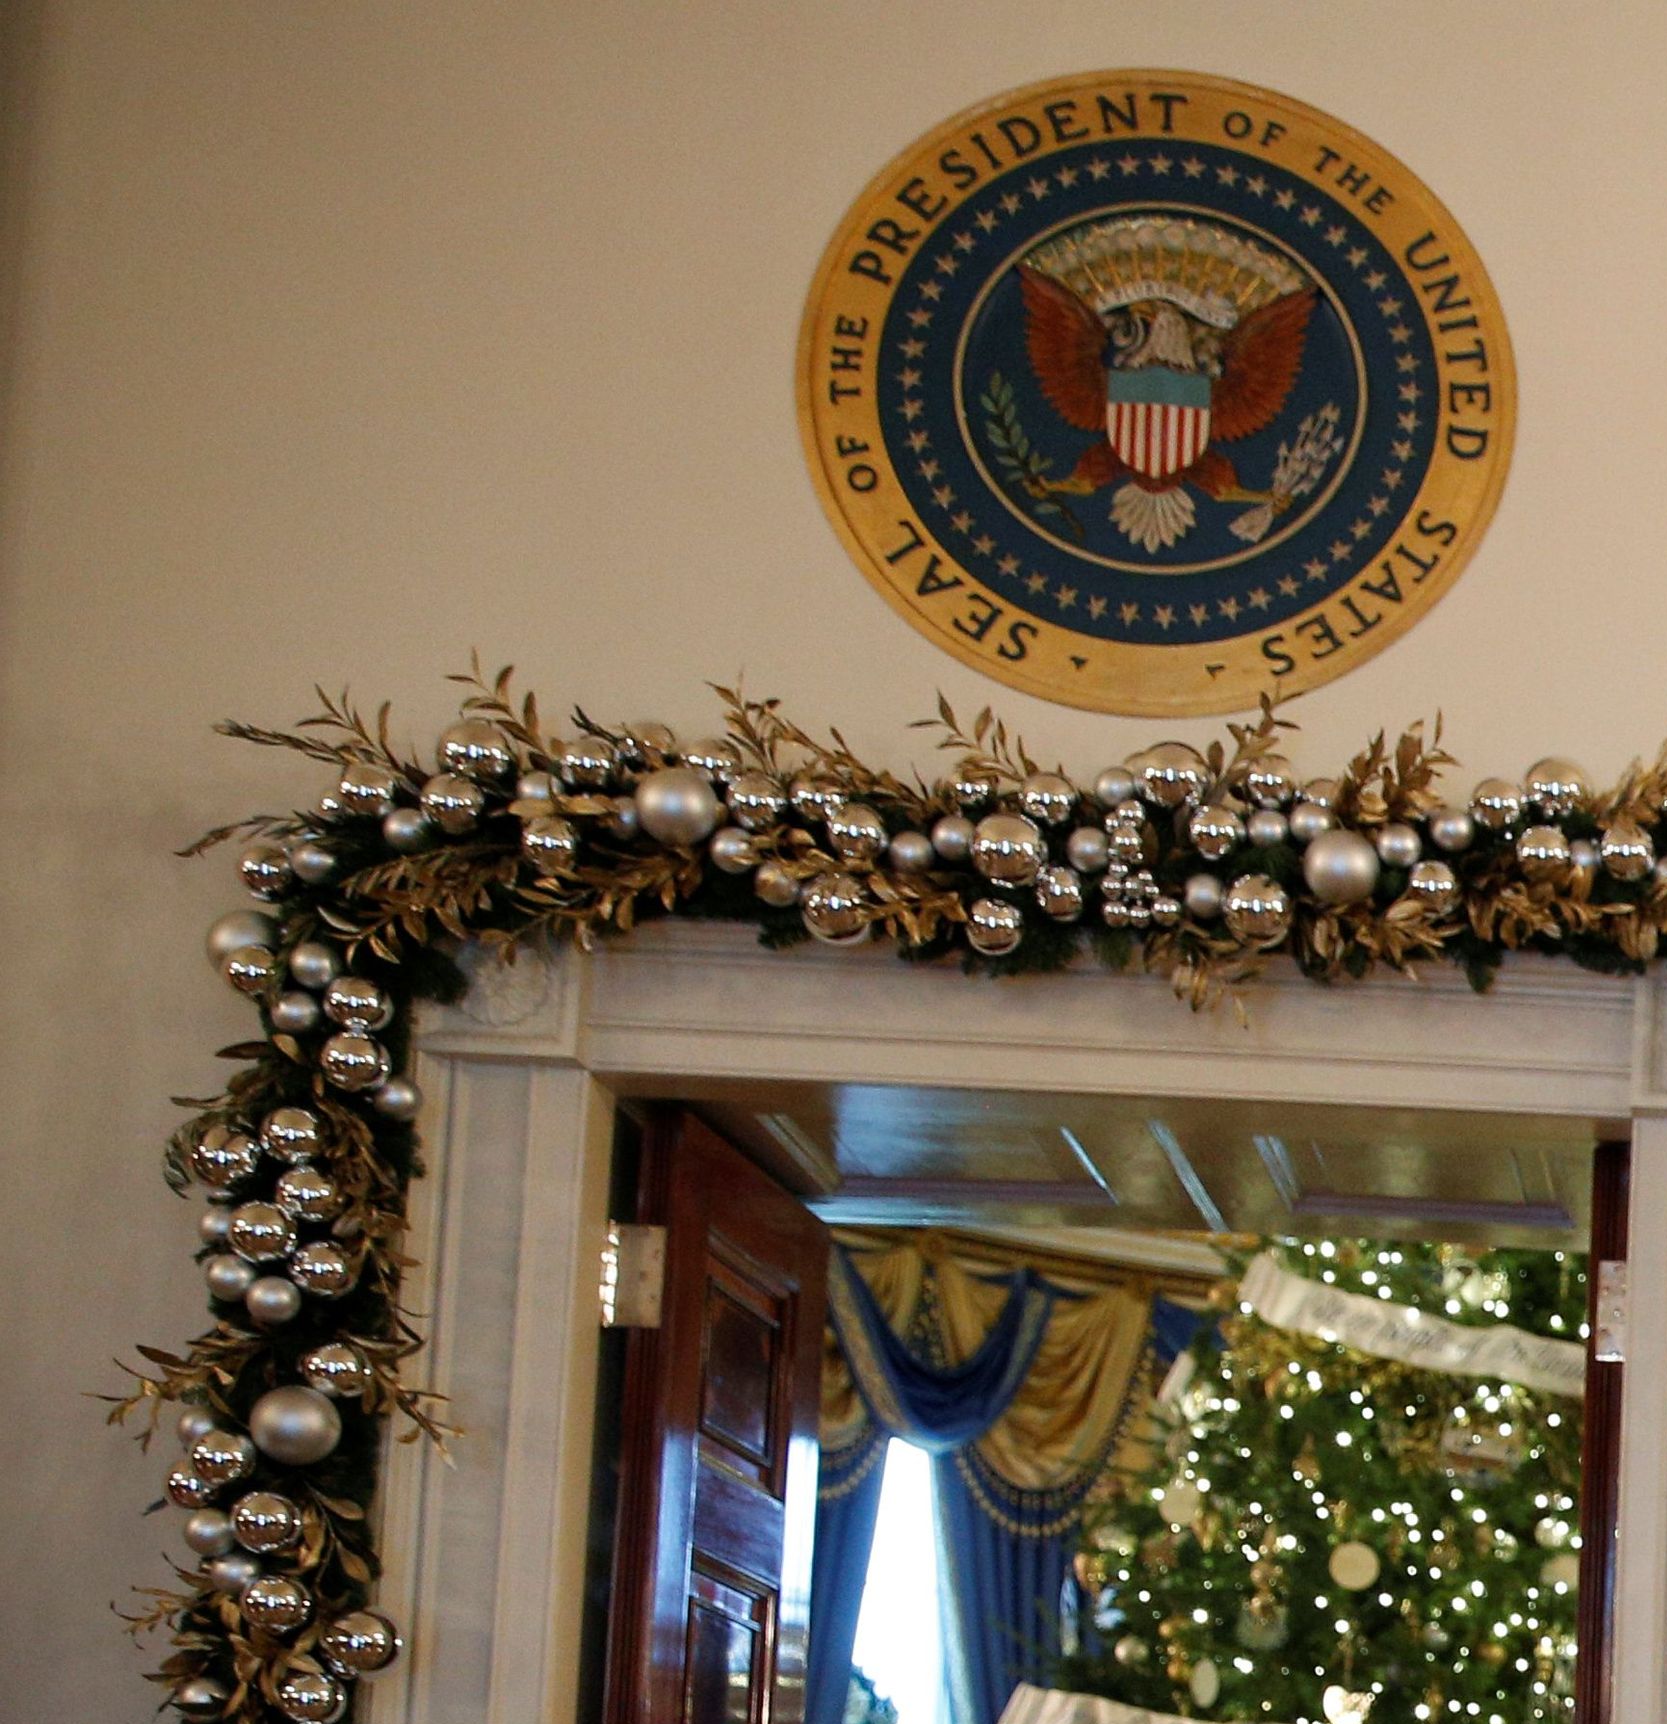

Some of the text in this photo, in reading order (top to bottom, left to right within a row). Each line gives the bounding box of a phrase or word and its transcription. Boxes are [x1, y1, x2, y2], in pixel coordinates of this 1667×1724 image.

[829, 92, 1491, 676] SEAL OF THE PRESIDENT OF THE UNITED STATES
